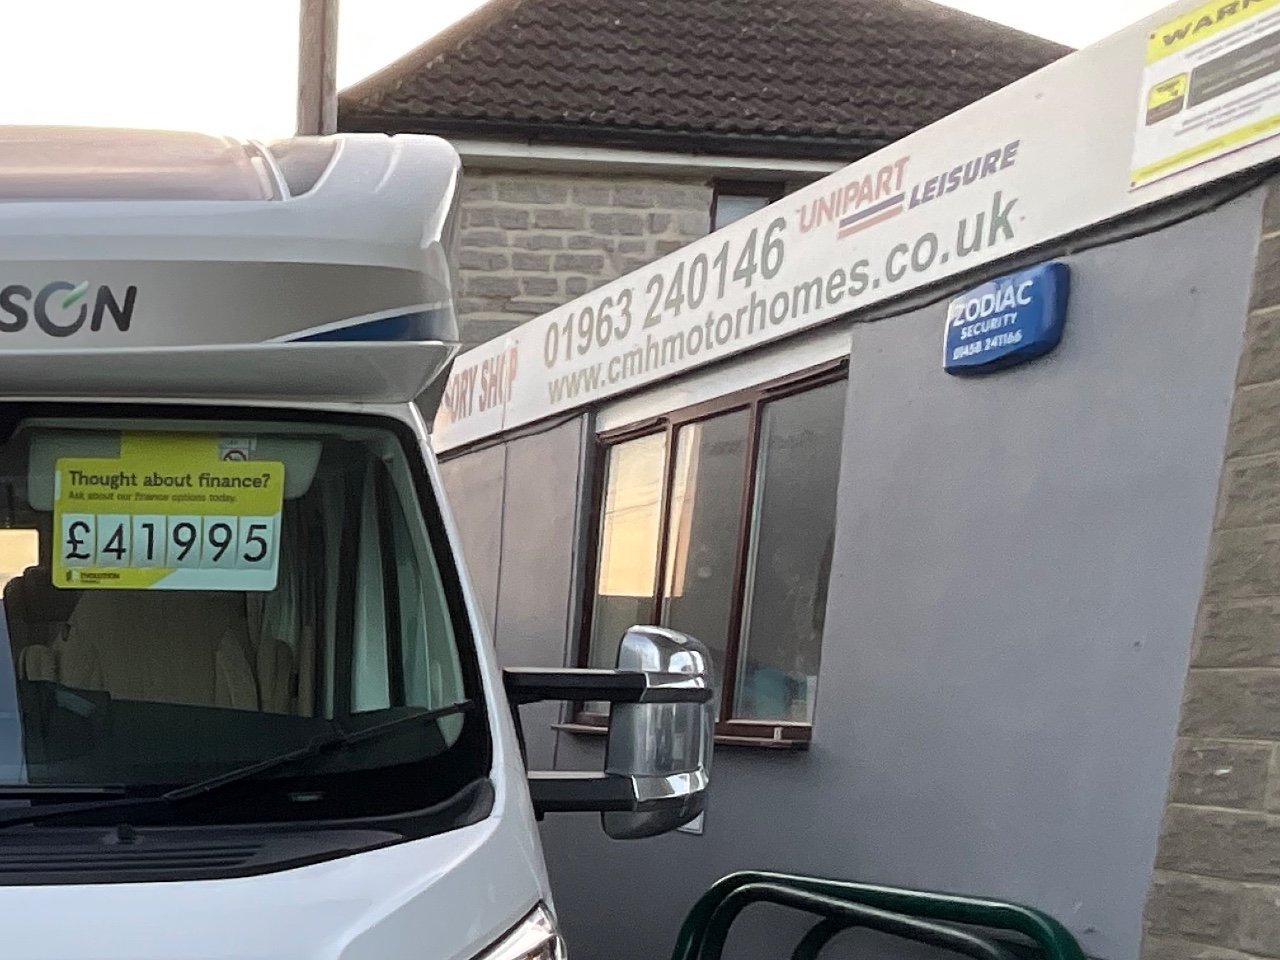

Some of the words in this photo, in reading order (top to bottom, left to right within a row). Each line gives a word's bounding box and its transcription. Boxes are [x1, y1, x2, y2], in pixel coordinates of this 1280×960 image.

[797, 155, 910, 233] UNIPART
[909, 139, 1020, 209] LEISURE
[543, 288, 632, 369] 01963
[643, 218, 786, 330] 240146
[548, 190, 1018, 405] www.cmhmotorhomes.co.uk
[953, 280, 1033, 326] ZODIAC
[960, 312, 1017, 340] SECURITY
[69, 470, 138, 490] Thought
[143, 472, 192, 487] about
[199, 473, 270, 488] finance?
[69, 491, 84, 500] Ask
[87, 491, 114, 500] about
[117, 493, 131, 501] our
[135, 491, 169, 501] finance
[172, 493, 206, 503] options
[65, 520, 268, 562] £41995
